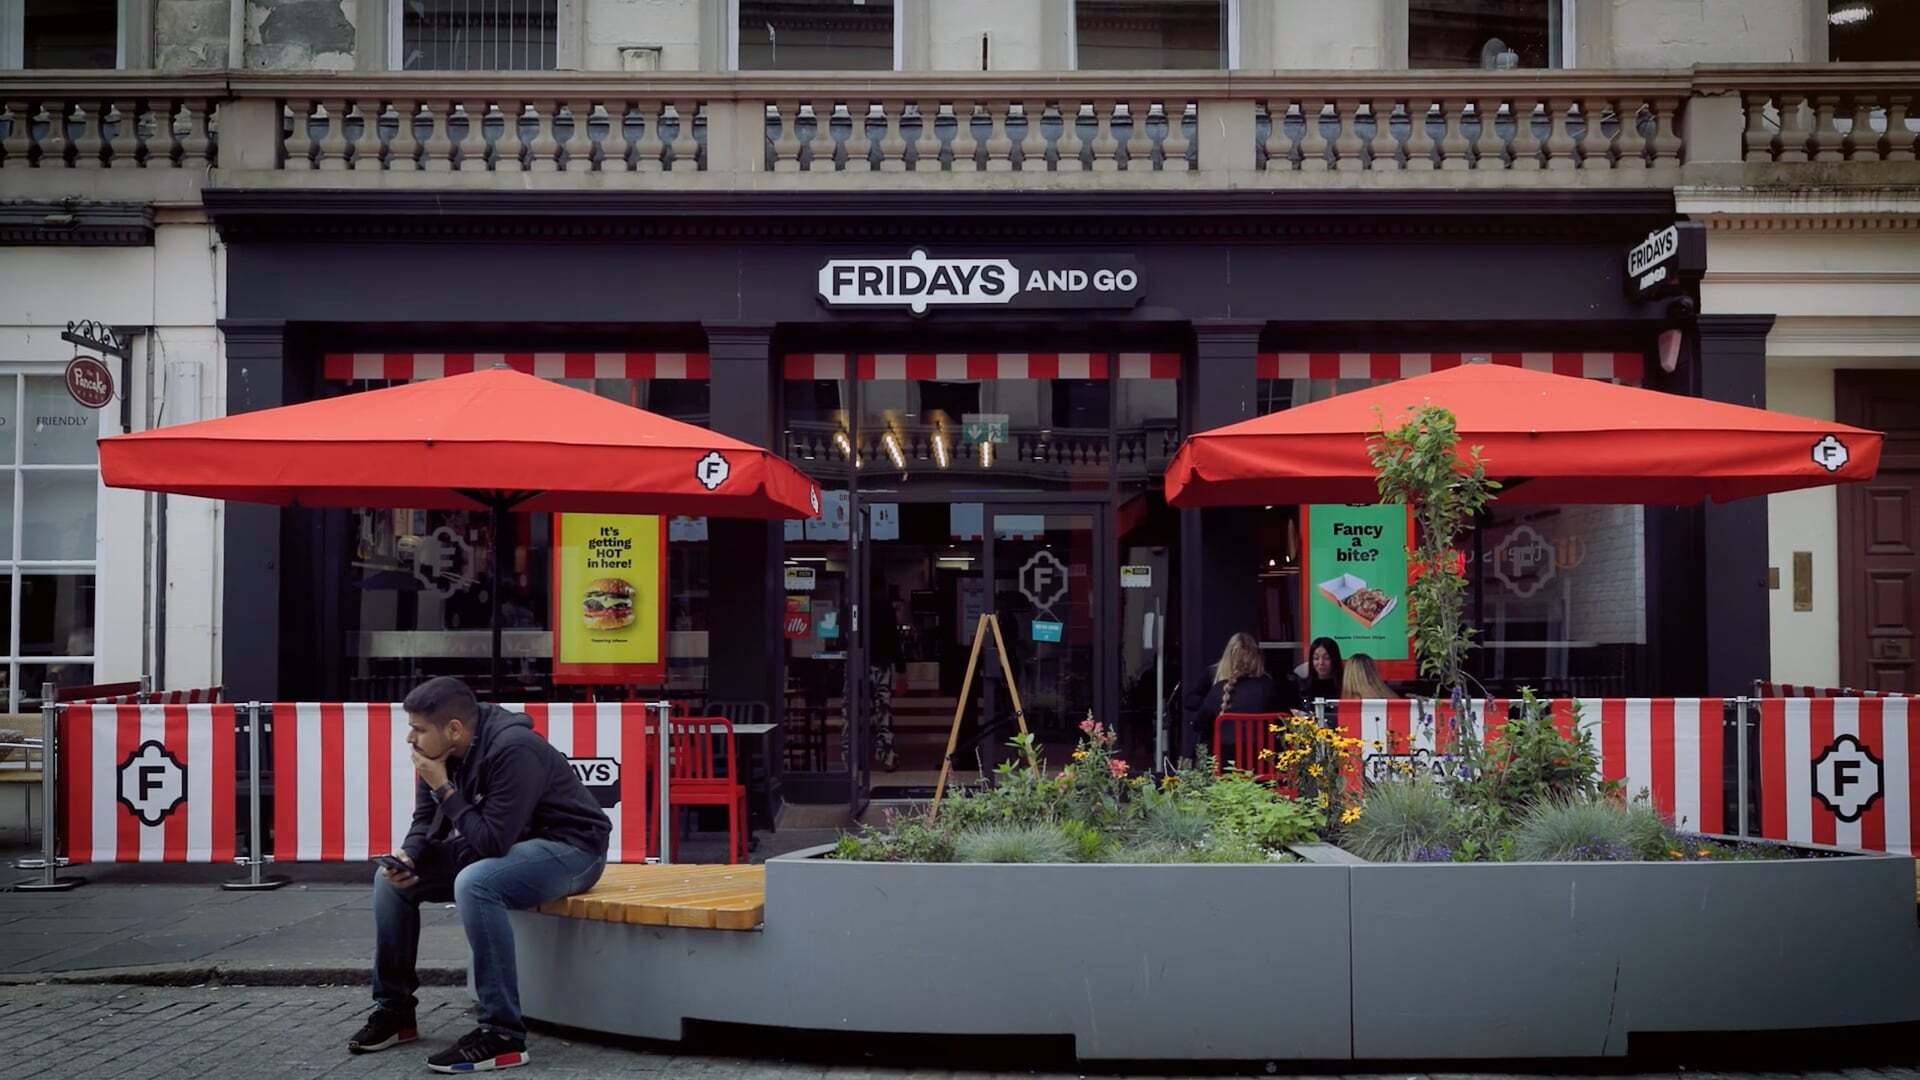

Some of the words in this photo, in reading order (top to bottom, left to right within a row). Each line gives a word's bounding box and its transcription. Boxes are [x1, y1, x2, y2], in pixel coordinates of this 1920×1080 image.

[1630, 231, 1673, 273] FRIDAYS
[832, 264, 1006, 297] FRIDAYS
[1025, 270, 1088, 291] AND
[1092, 269, 1138, 292] GO
[36, 416, 88, 426] FRIENDLY
[1823, 446, 1837, 461] F
[706, 462, 720, 479] F
[1333, 523, 1383, 539] Fancy
[588, 538, 632, 550] getting
[1351, 537, 1362, 547] a
[596, 549, 622, 558] HOT
[1336, 549, 1379, 562] bite?
[587, 559, 599, 569] in
[601, 559, 632, 569] here!
[1034, 567, 1053, 592] F
[139, 765, 166, 801] F
[1834, 760, 1861, 797] F
